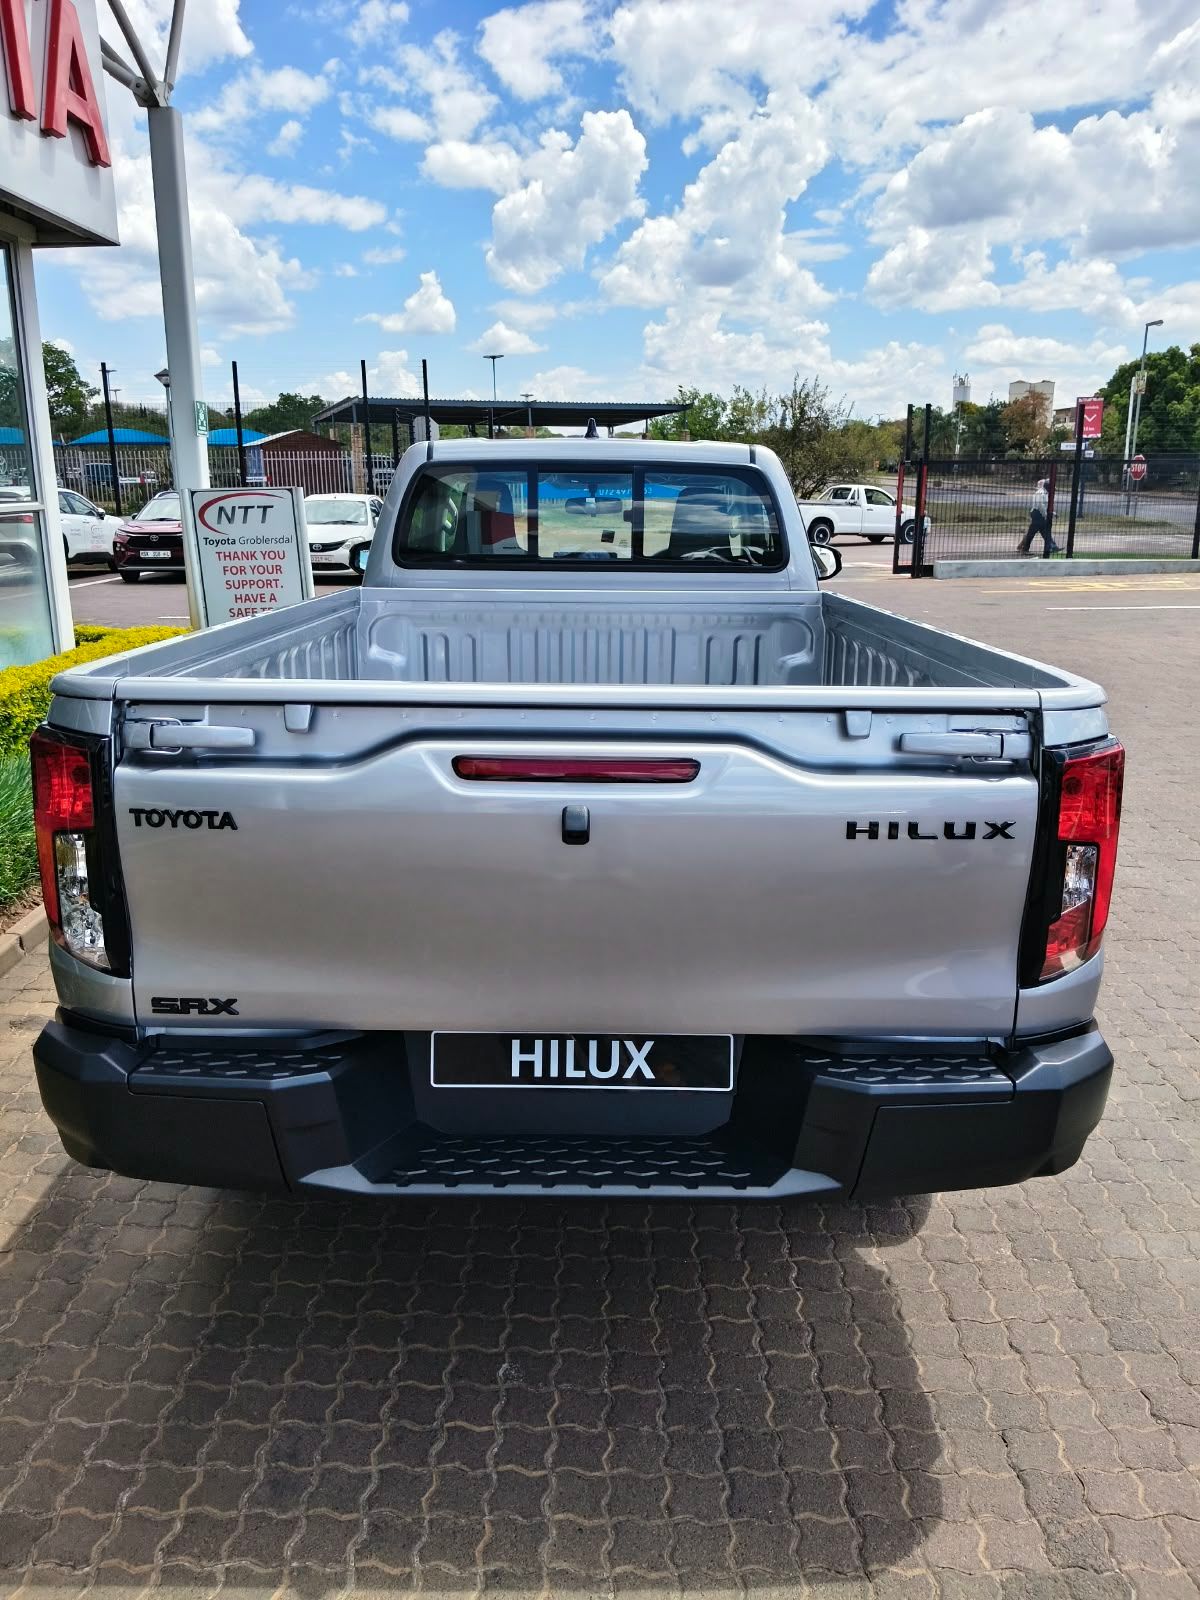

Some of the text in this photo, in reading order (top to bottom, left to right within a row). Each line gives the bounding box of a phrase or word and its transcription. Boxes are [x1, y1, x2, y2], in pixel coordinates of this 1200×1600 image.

[1131, 463, 1145, 472] STOP
[216, 505, 274, 525] NTT
[203, 535, 293, 548] Toyota Groblersdal
[216, 550, 286, 562] THANK YOU
[223, 564, 283, 576] FOR YOUR
[225, 578, 284, 590] SUPPORT.
[234, 592, 278, 604] HAVE A
[228, 607, 258, 618] SAFE
[128, 808, 238, 830] TOYOTA
[846, 821, 1017, 840] HILUX
[150, 996, 240, 1016] SRX
[511, 1039, 656, 1079] HILUX
